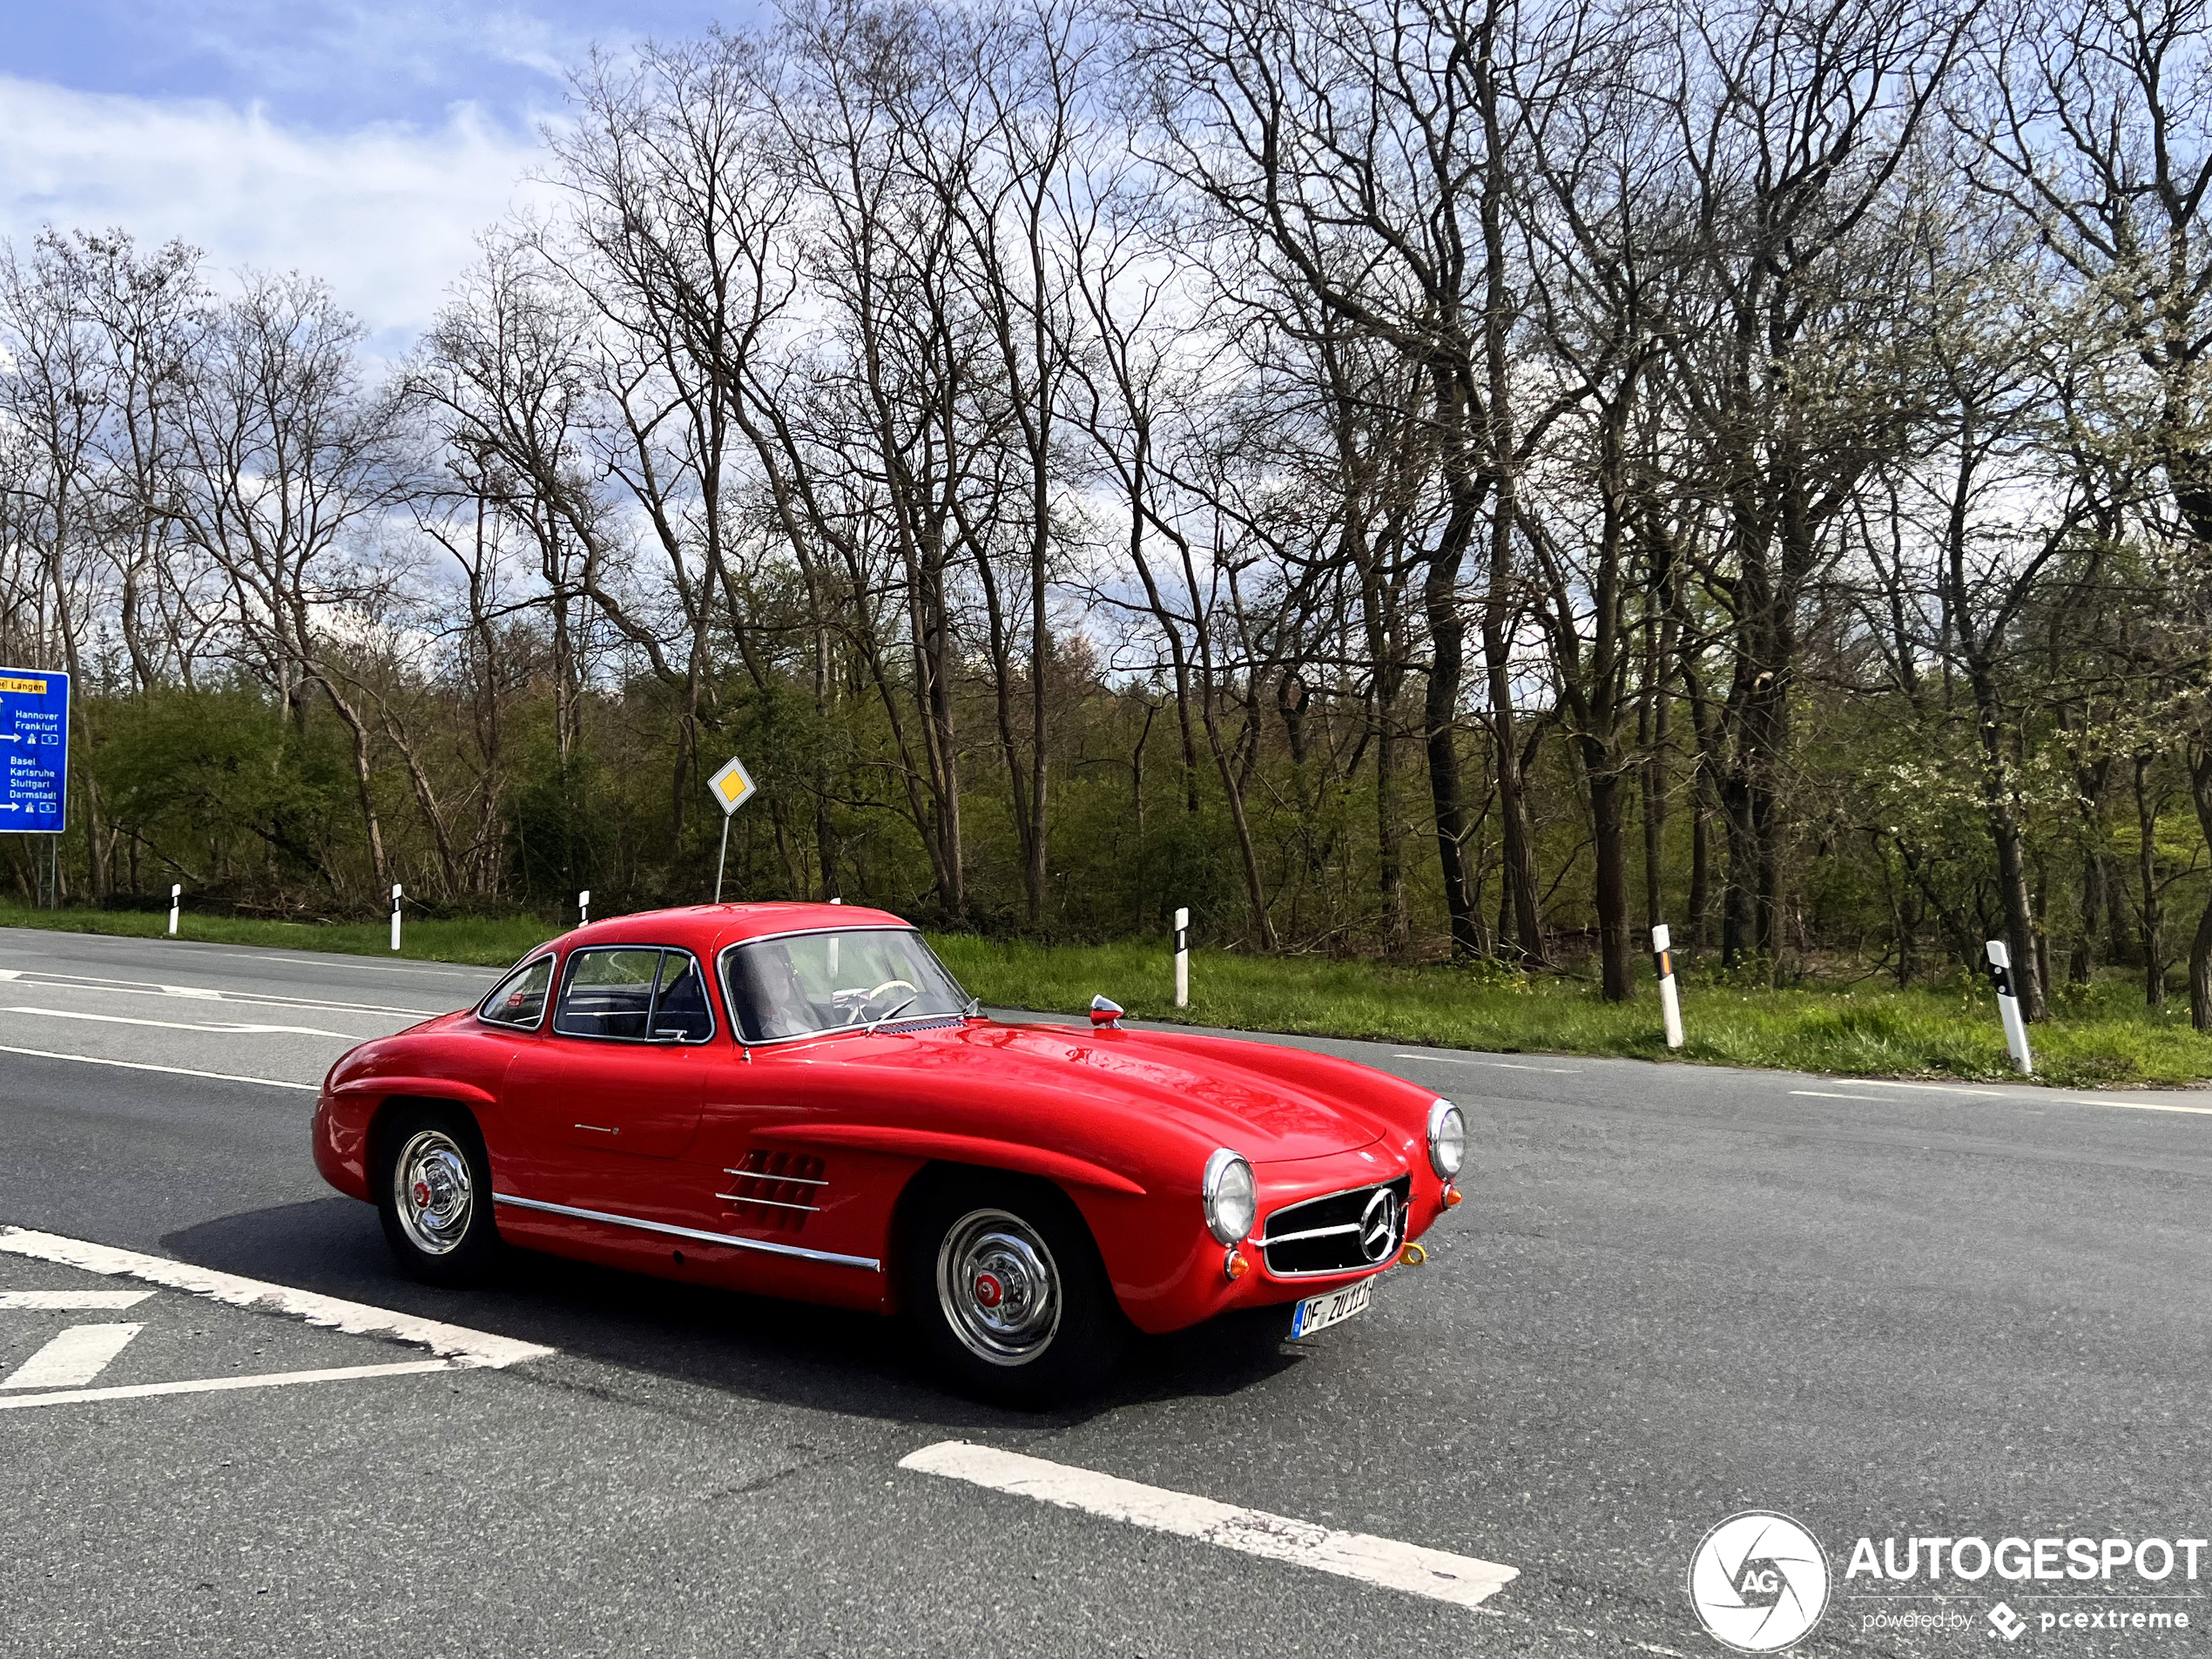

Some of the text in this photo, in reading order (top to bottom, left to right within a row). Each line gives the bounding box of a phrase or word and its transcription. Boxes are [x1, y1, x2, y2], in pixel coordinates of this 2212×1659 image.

[11, 681, 44, 692] Langen
[16, 710, 58, 720] Hannover
[15, 721, 57, 732] Frankfurt
[10, 756, 36, 765] Basel
[10, 768, 55, 778] Karlsruhe
[10, 779, 50, 790] Stuttgart
[10, 790, 57, 799] Darmstadt
[1302, 1300, 1323, 1331] OF
[1327, 1293, 1348, 1322] ZU
